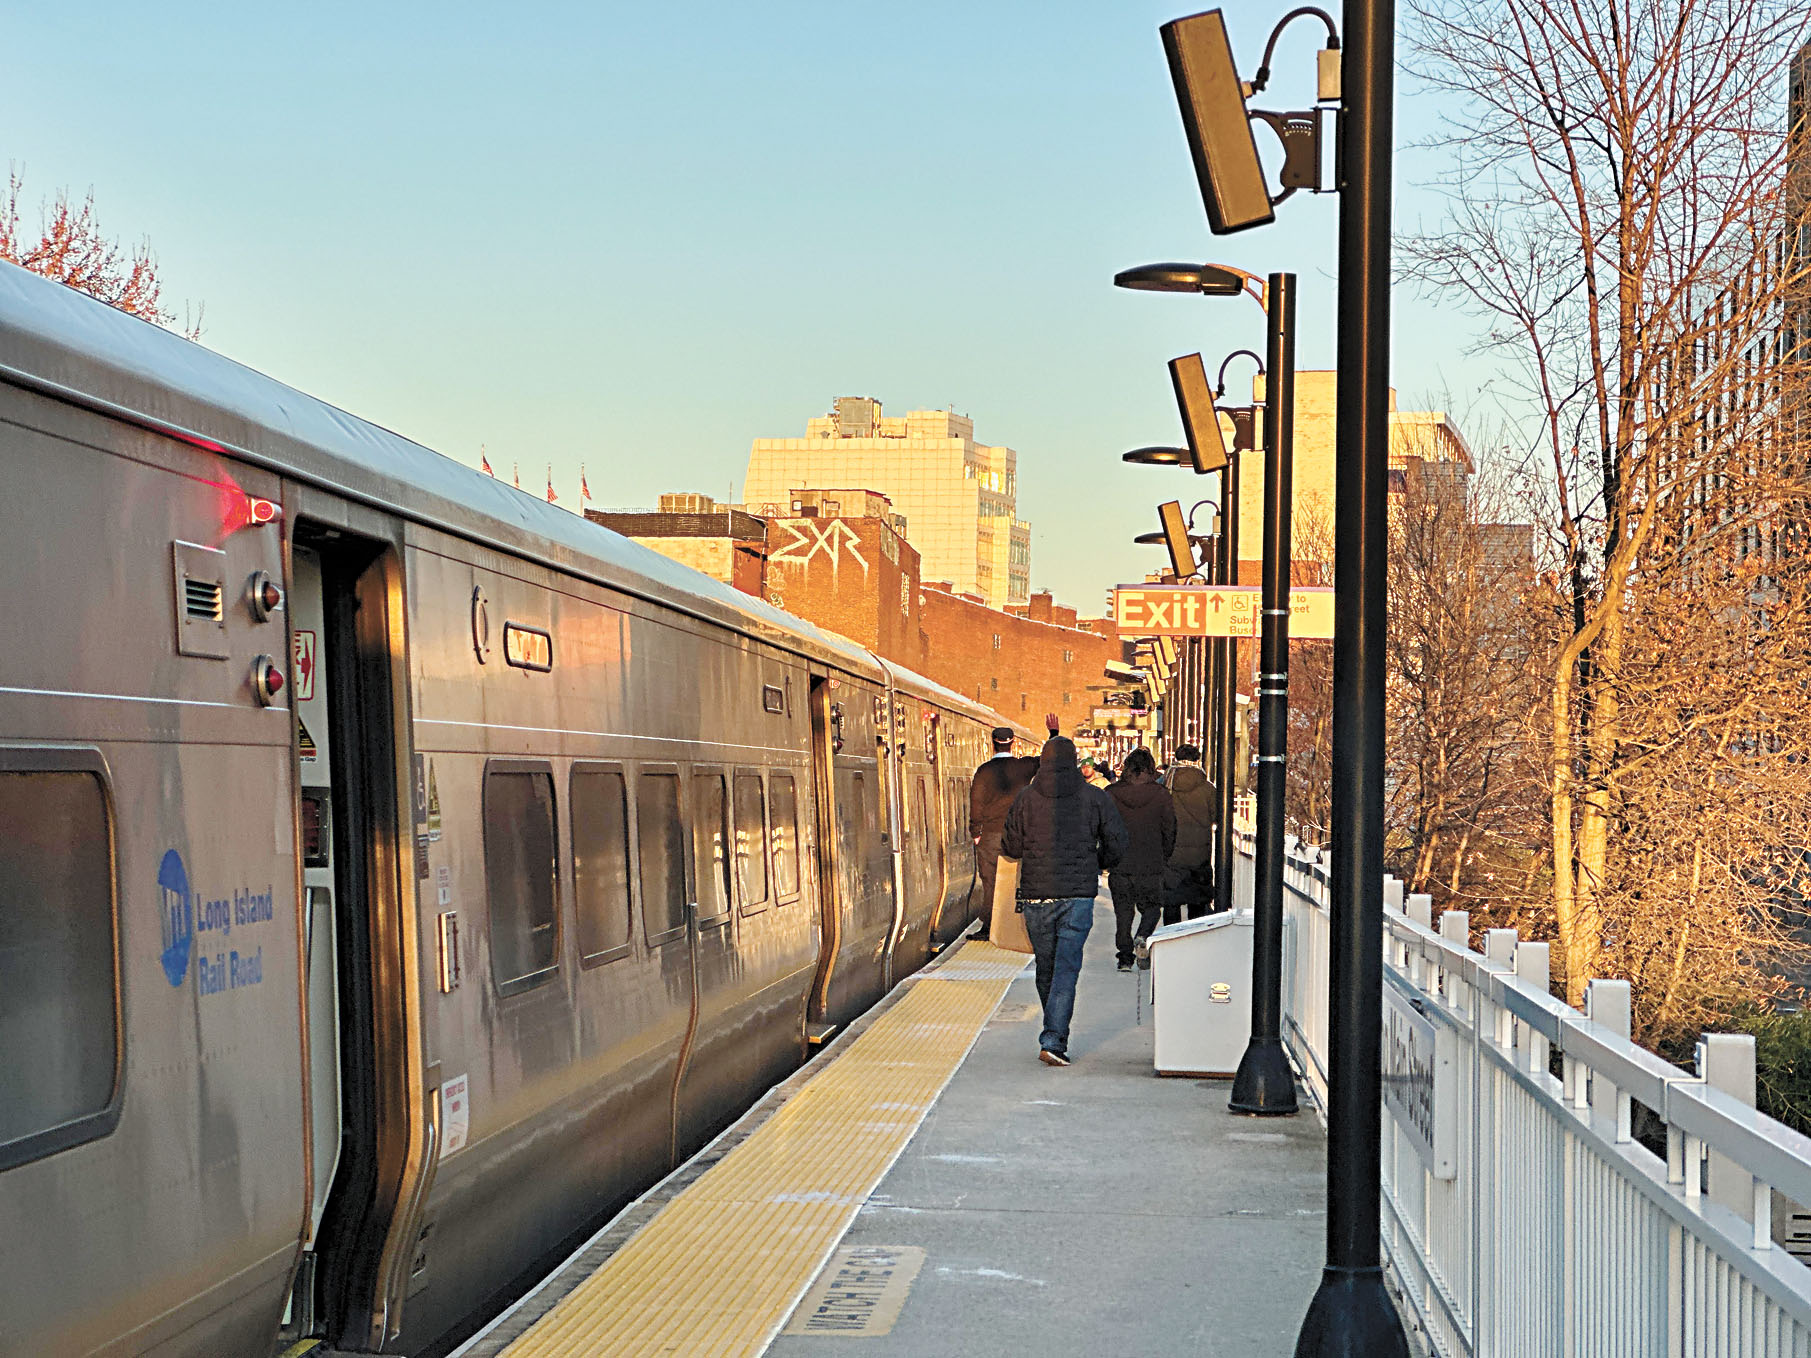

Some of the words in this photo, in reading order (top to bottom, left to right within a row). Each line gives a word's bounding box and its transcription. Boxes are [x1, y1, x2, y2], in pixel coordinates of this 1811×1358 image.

[1118, 592, 1200, 628] Exit
[1296, 594, 1307, 603] to
[197, 893, 230, 936] Long
[234, 883, 273, 926] Island
[199, 953, 226, 996] Rail
[229, 945, 262, 989] Road
[845, 1248, 903, 1267] GAP
[830, 1269, 893, 1288] THE
[803, 1292, 882, 1330] WATCH
